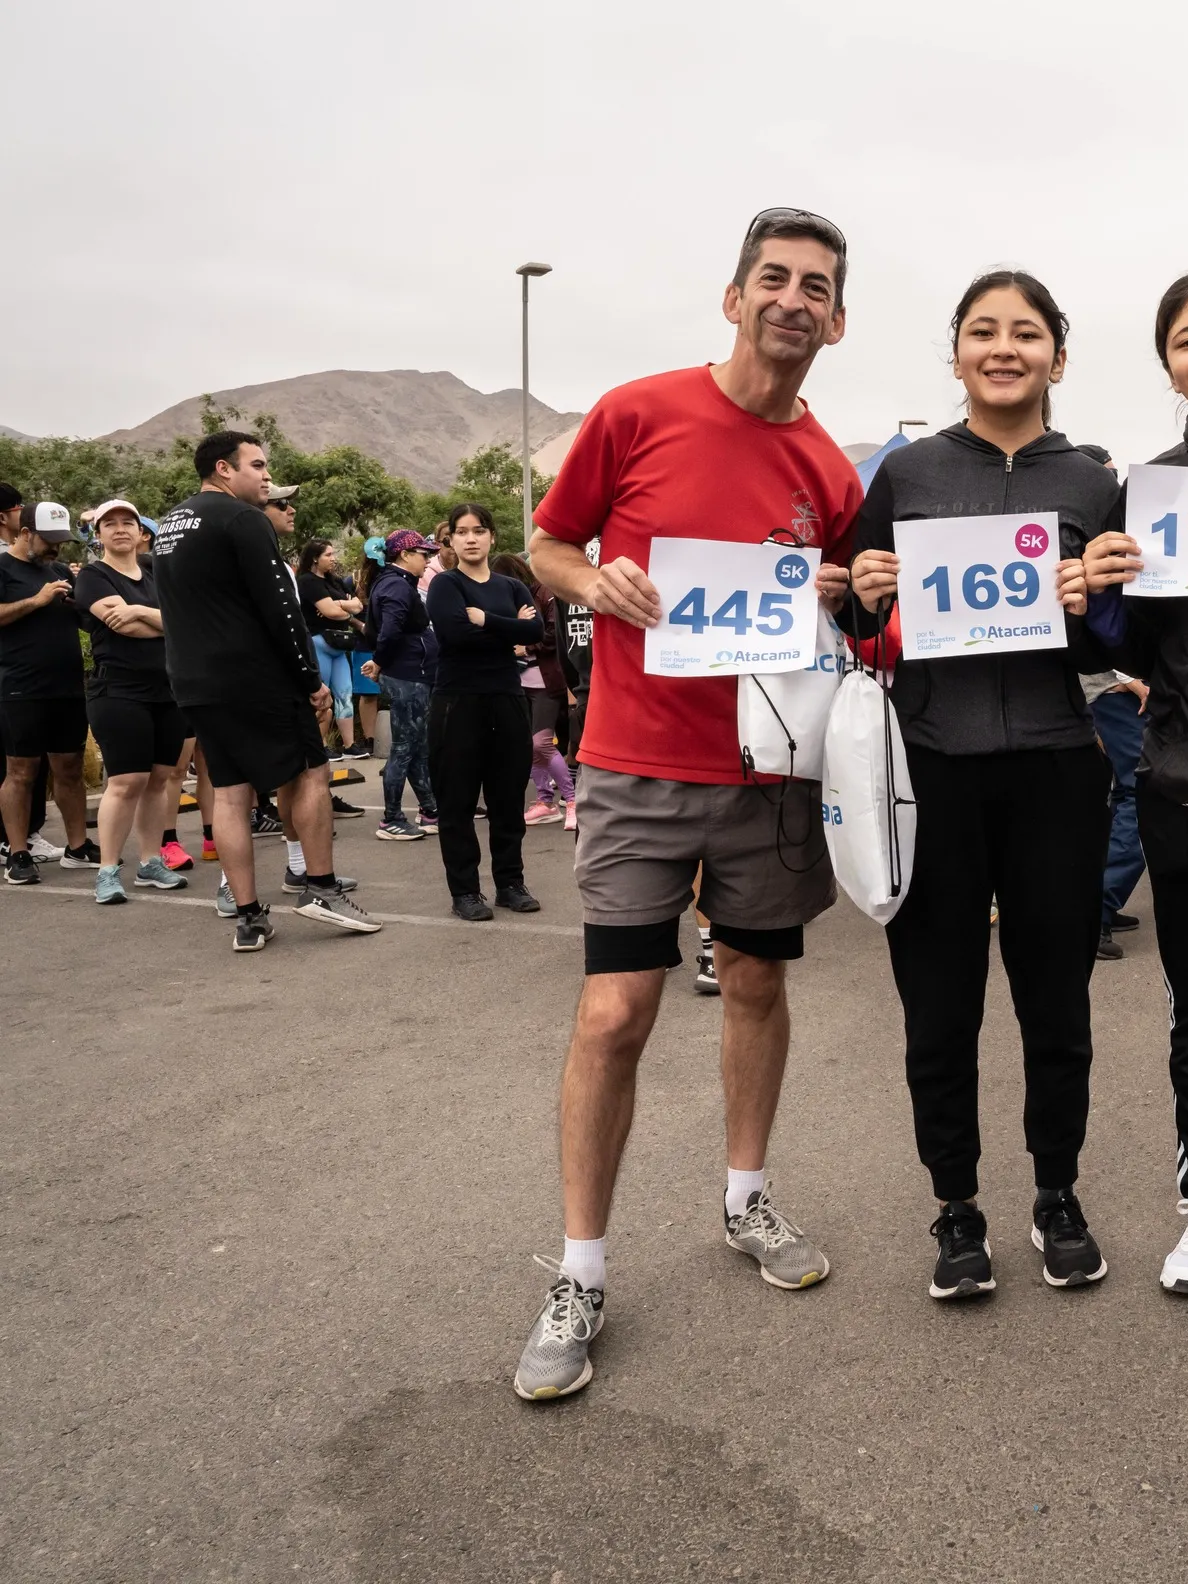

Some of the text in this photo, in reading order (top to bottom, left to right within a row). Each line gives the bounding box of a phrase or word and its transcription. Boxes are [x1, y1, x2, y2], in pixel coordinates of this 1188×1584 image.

[1020, 534, 1044, 549] 5K
[780, 564, 804, 580] 5K
[922, 561, 1040, 613] 169
[669, 587, 794, 636] 445
[987, 625, 1052, 639] Atacama
[733, 650, 801, 662] Atacama
